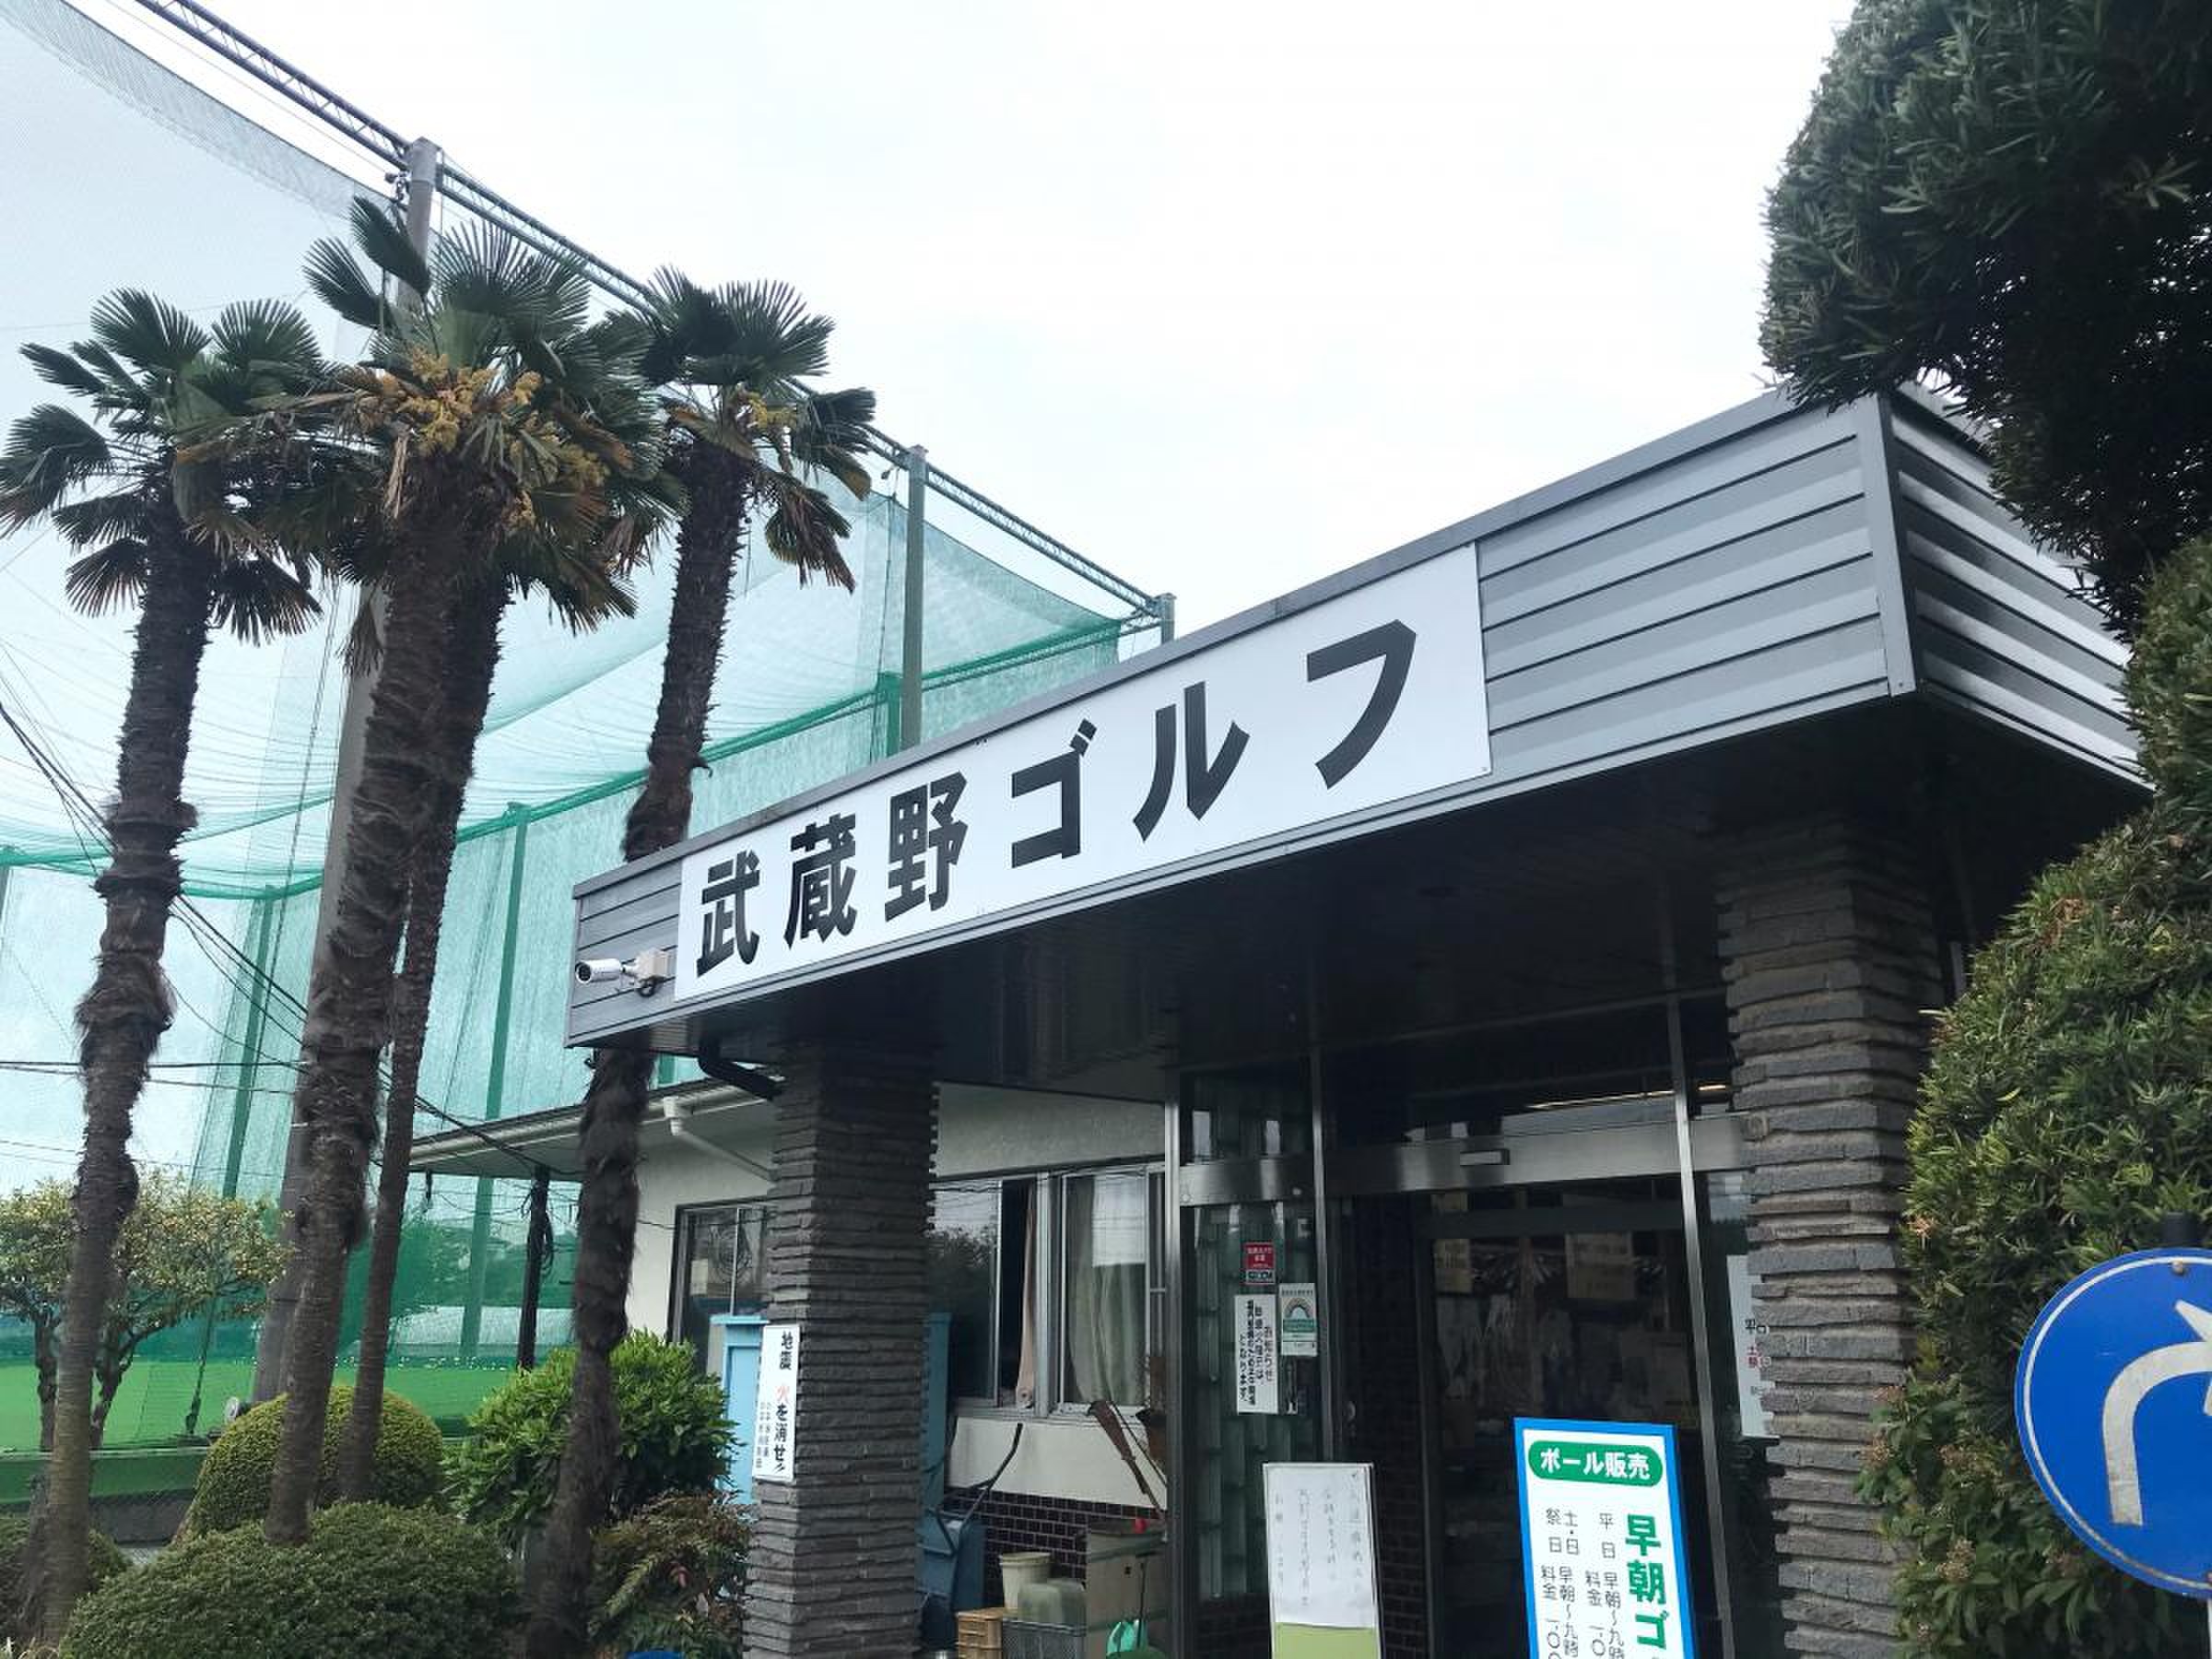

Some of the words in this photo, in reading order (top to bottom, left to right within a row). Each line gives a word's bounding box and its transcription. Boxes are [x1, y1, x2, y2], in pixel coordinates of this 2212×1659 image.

[696, 619, 1417, 978] 武蔵野ゴルフ
[1599, 1512, 1616, 1559] 平日
[1625, 1512, 1670, 1659] 早朝ゴ
